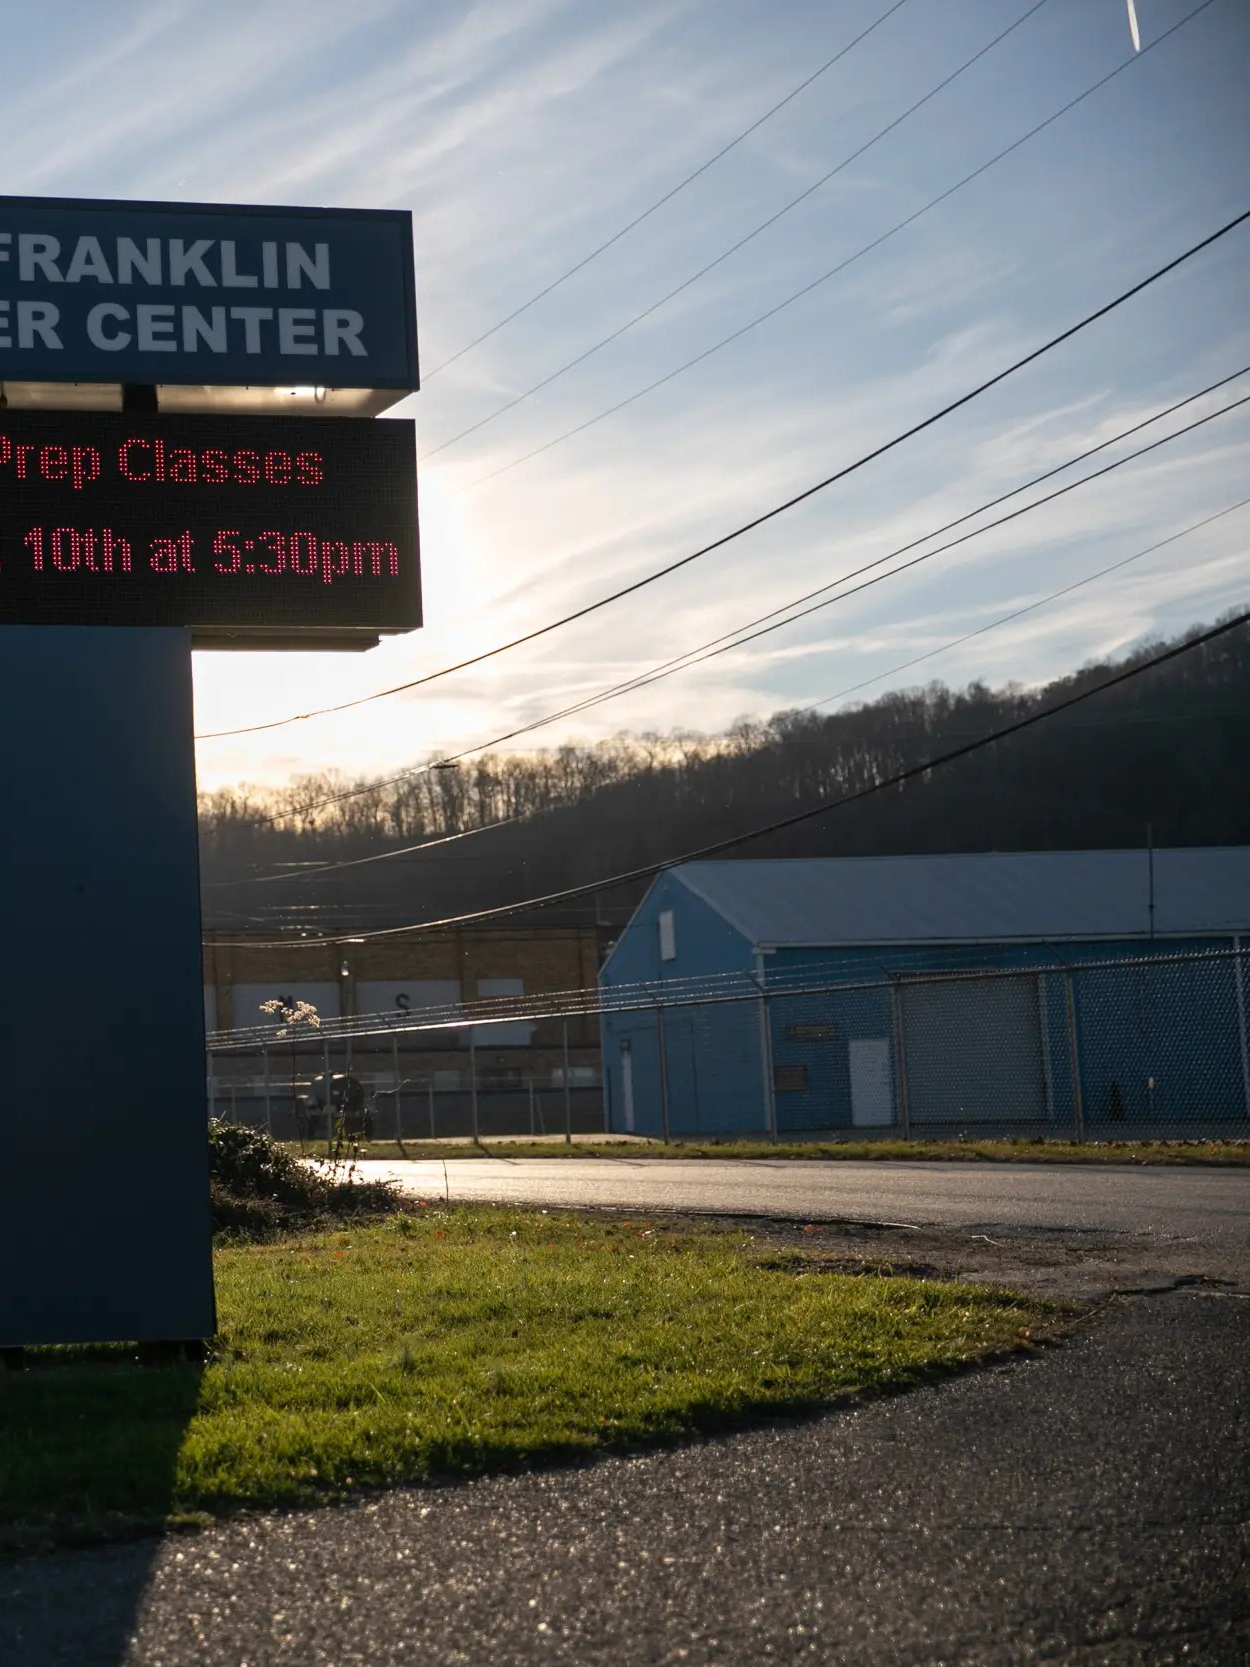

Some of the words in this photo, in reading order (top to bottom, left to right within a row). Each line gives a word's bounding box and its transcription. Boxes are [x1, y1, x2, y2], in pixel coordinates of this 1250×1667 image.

[87, 303, 368, 356] CENTER
[118, 438, 324, 486] Classes
[24, 527, 132, 573] 10th
[148, 529, 196, 573] at
[213, 530, 399, 584] 5:30pm
[396, 993, 410, 1018] S
